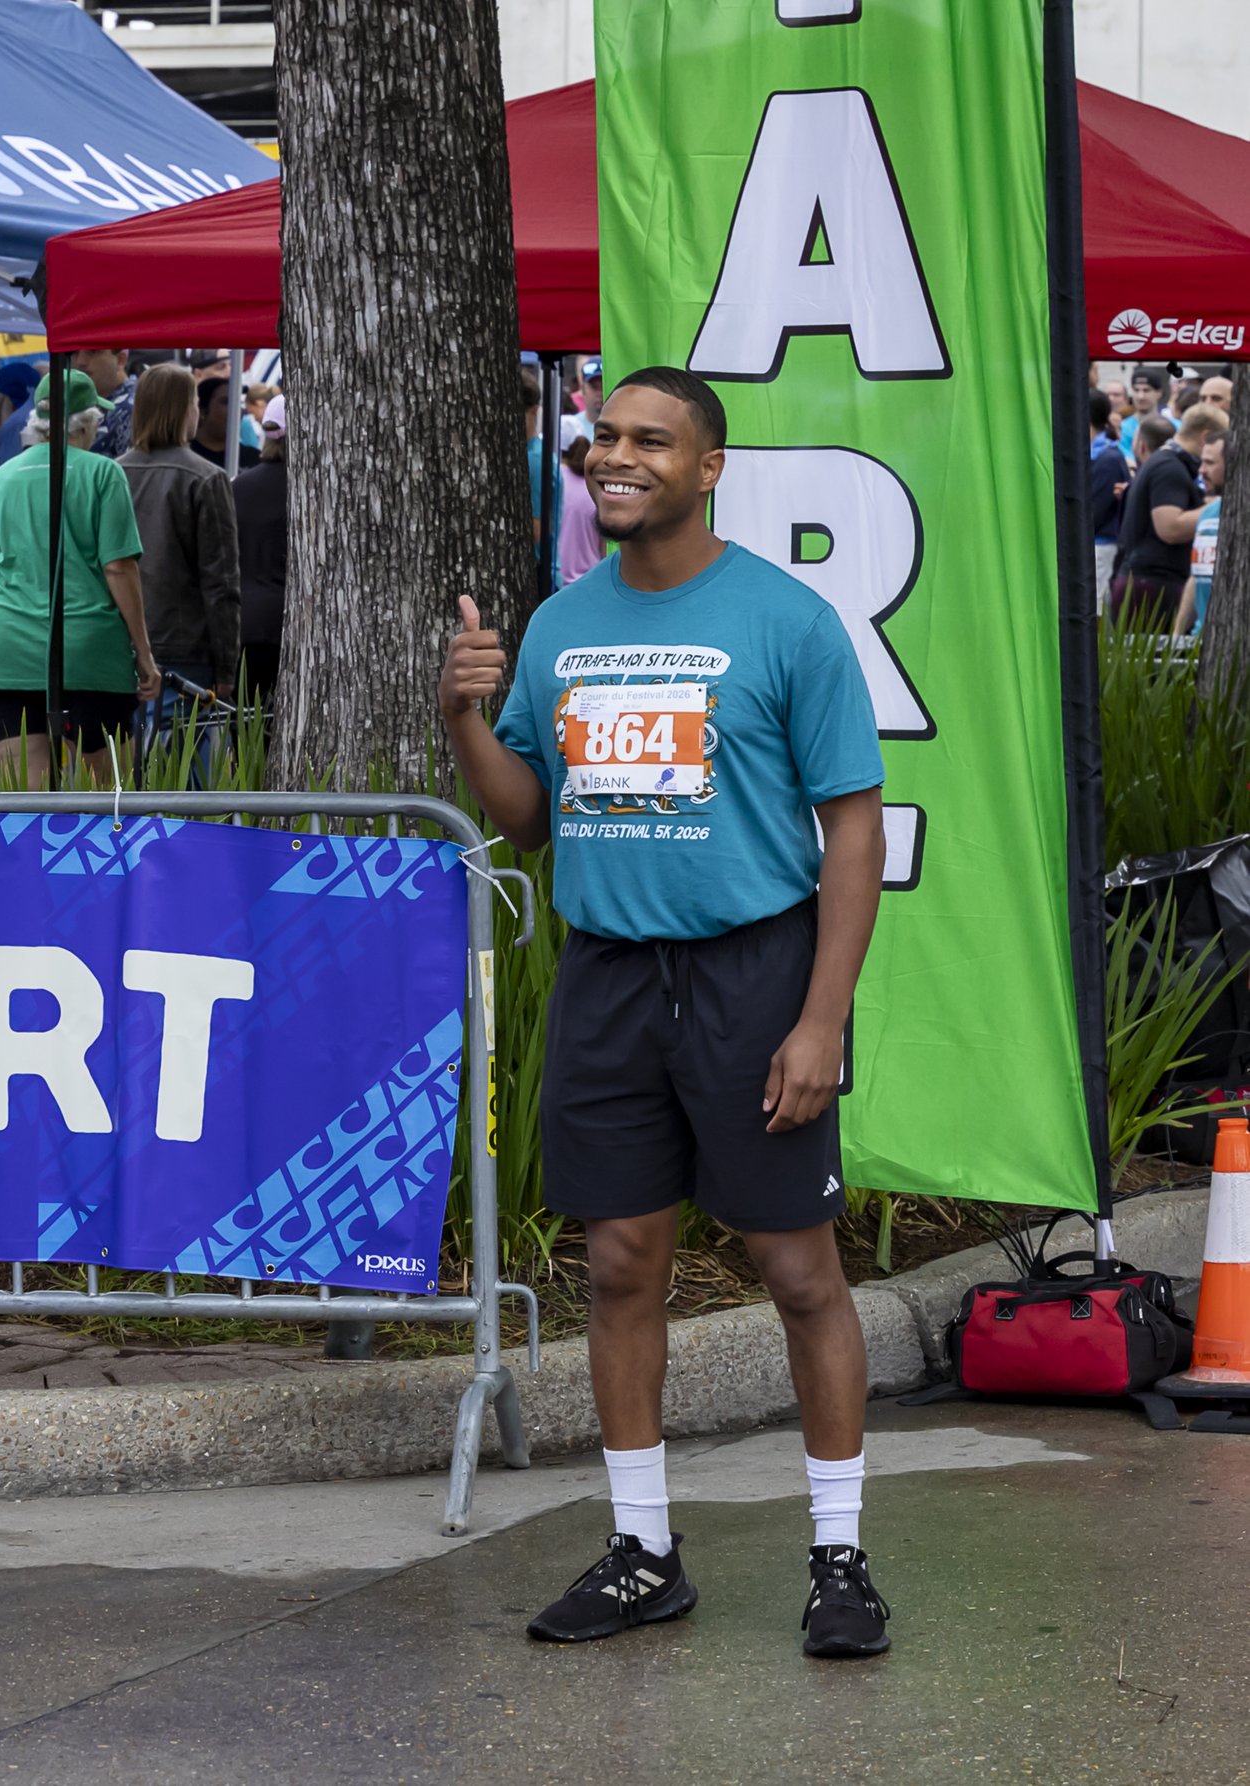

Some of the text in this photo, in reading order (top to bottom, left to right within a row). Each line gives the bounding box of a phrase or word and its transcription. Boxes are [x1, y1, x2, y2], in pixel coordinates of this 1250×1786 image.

[1151, 318, 1245, 350] Sekey
[560, 652, 723, 672] ATTRAPE-MOI SI TU PEUX!
[580, 690, 691, 702] Courir du Festival 2026
[584, 713, 677, 763] 864
[594, 777, 630, 789] BANK
[578, 824, 597, 838] DU
[598, 824, 650, 839] FESTIVAL
[654, 825, 673, 839] 5K
[674, 826, 710, 840] 2026
